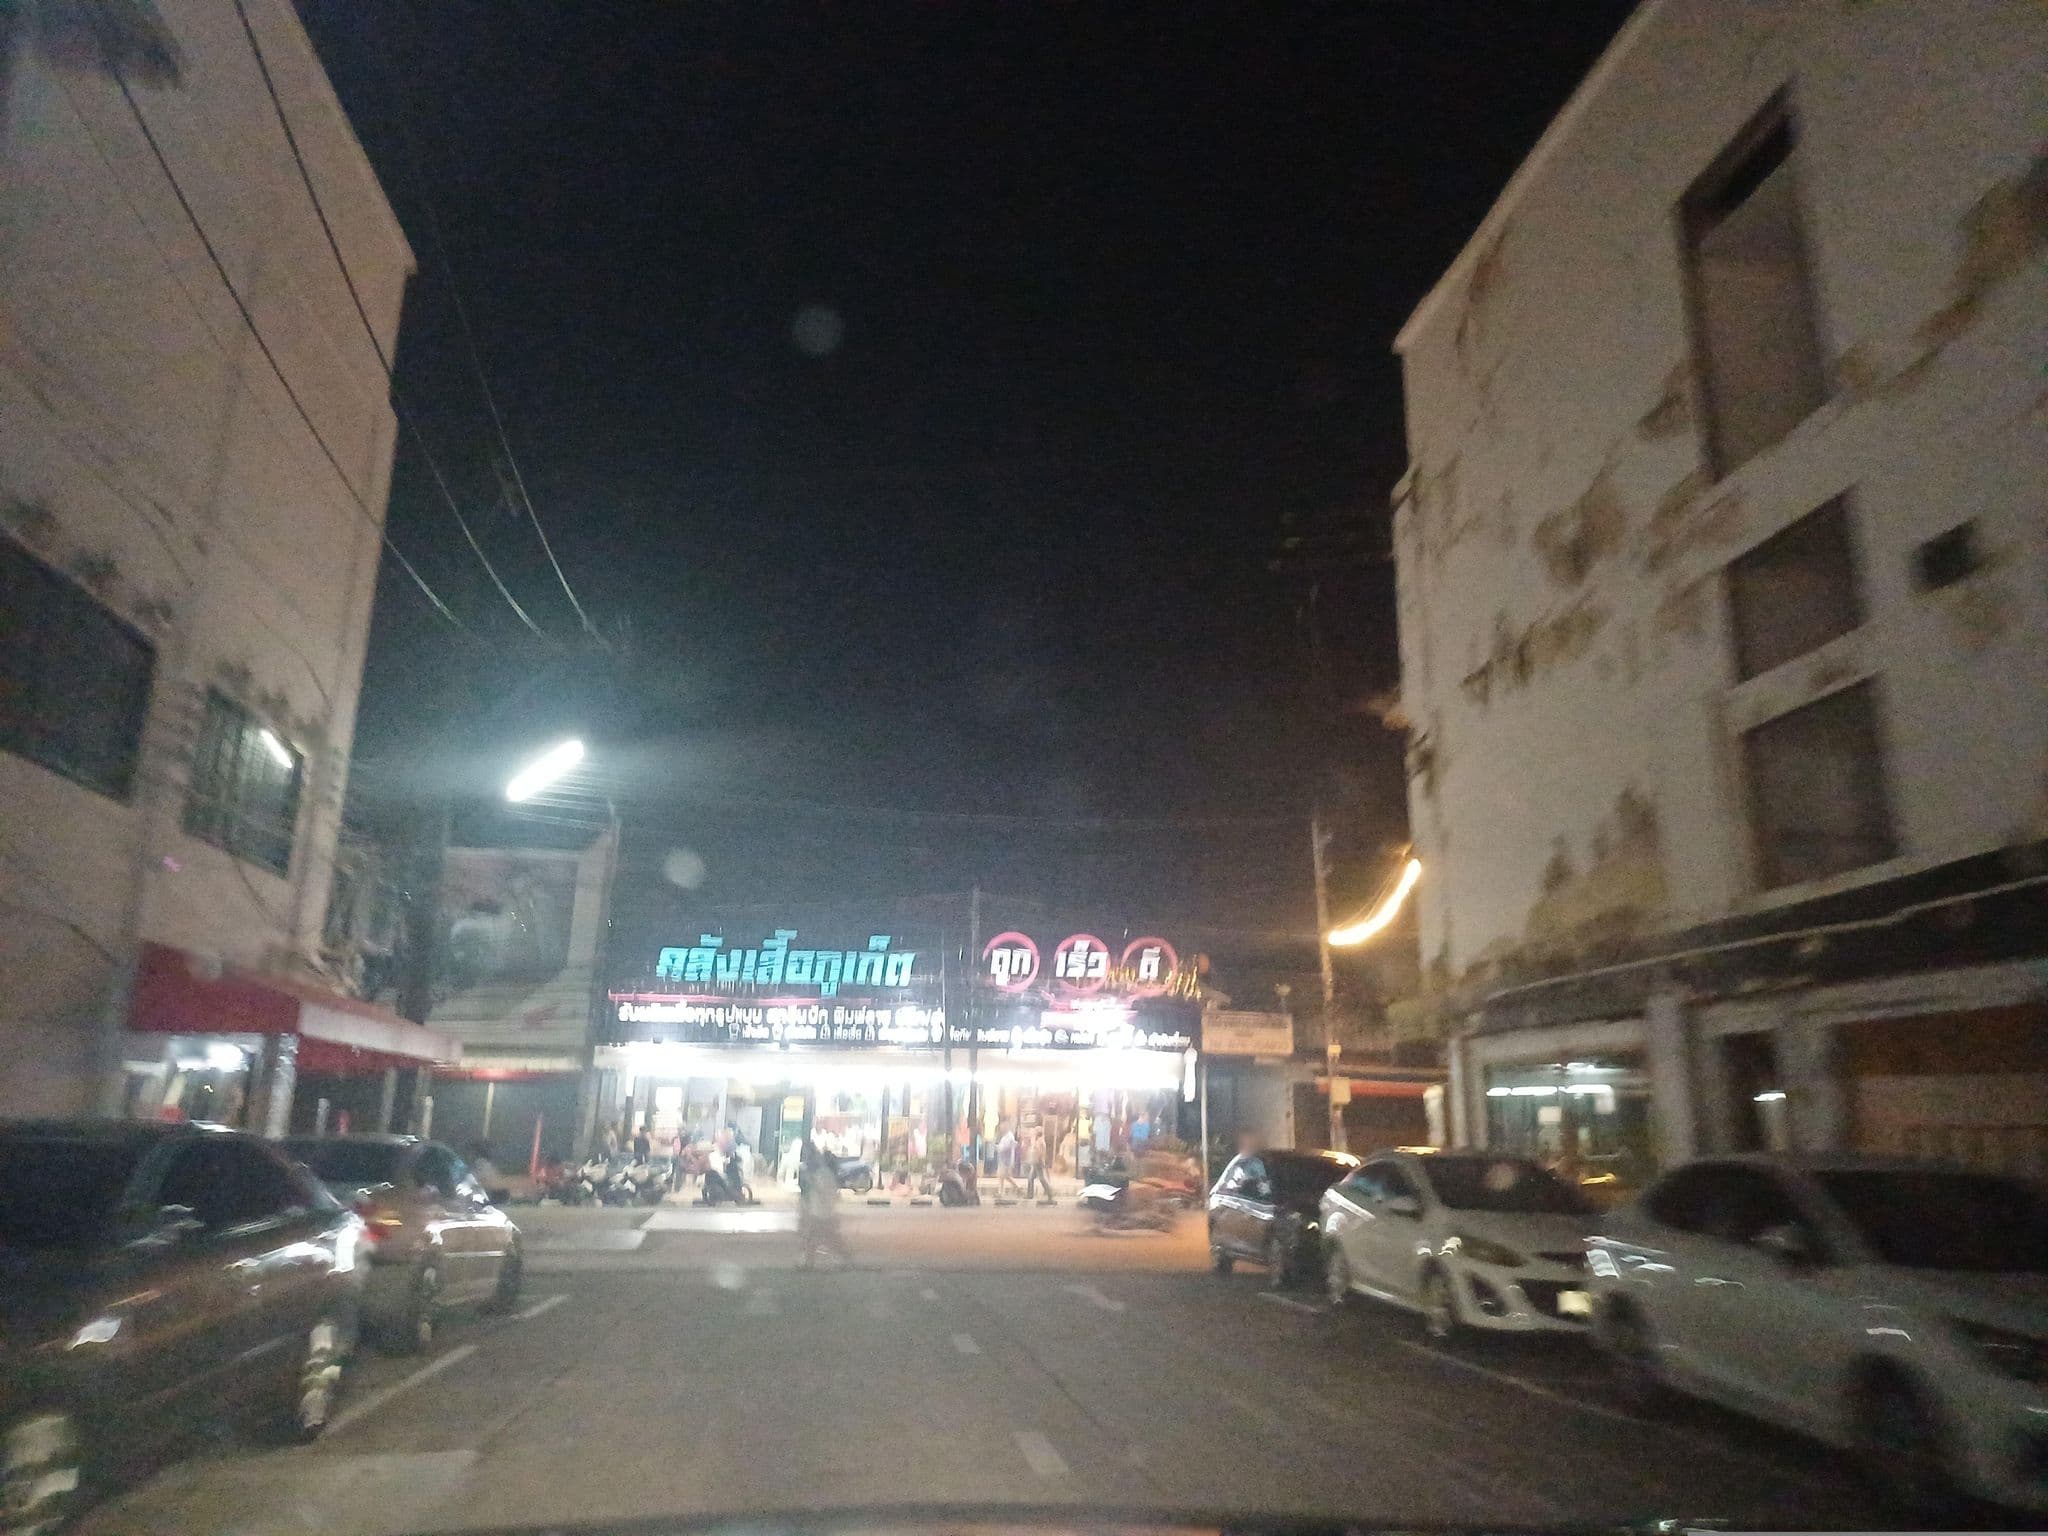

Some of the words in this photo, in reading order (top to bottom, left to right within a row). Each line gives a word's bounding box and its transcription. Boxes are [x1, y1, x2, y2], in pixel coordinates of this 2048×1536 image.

[990, 948, 1032, 986] ถูก
[1055, 940, 1109, 978] เร็ว
[1138, 946, 1161, 981] ดี
